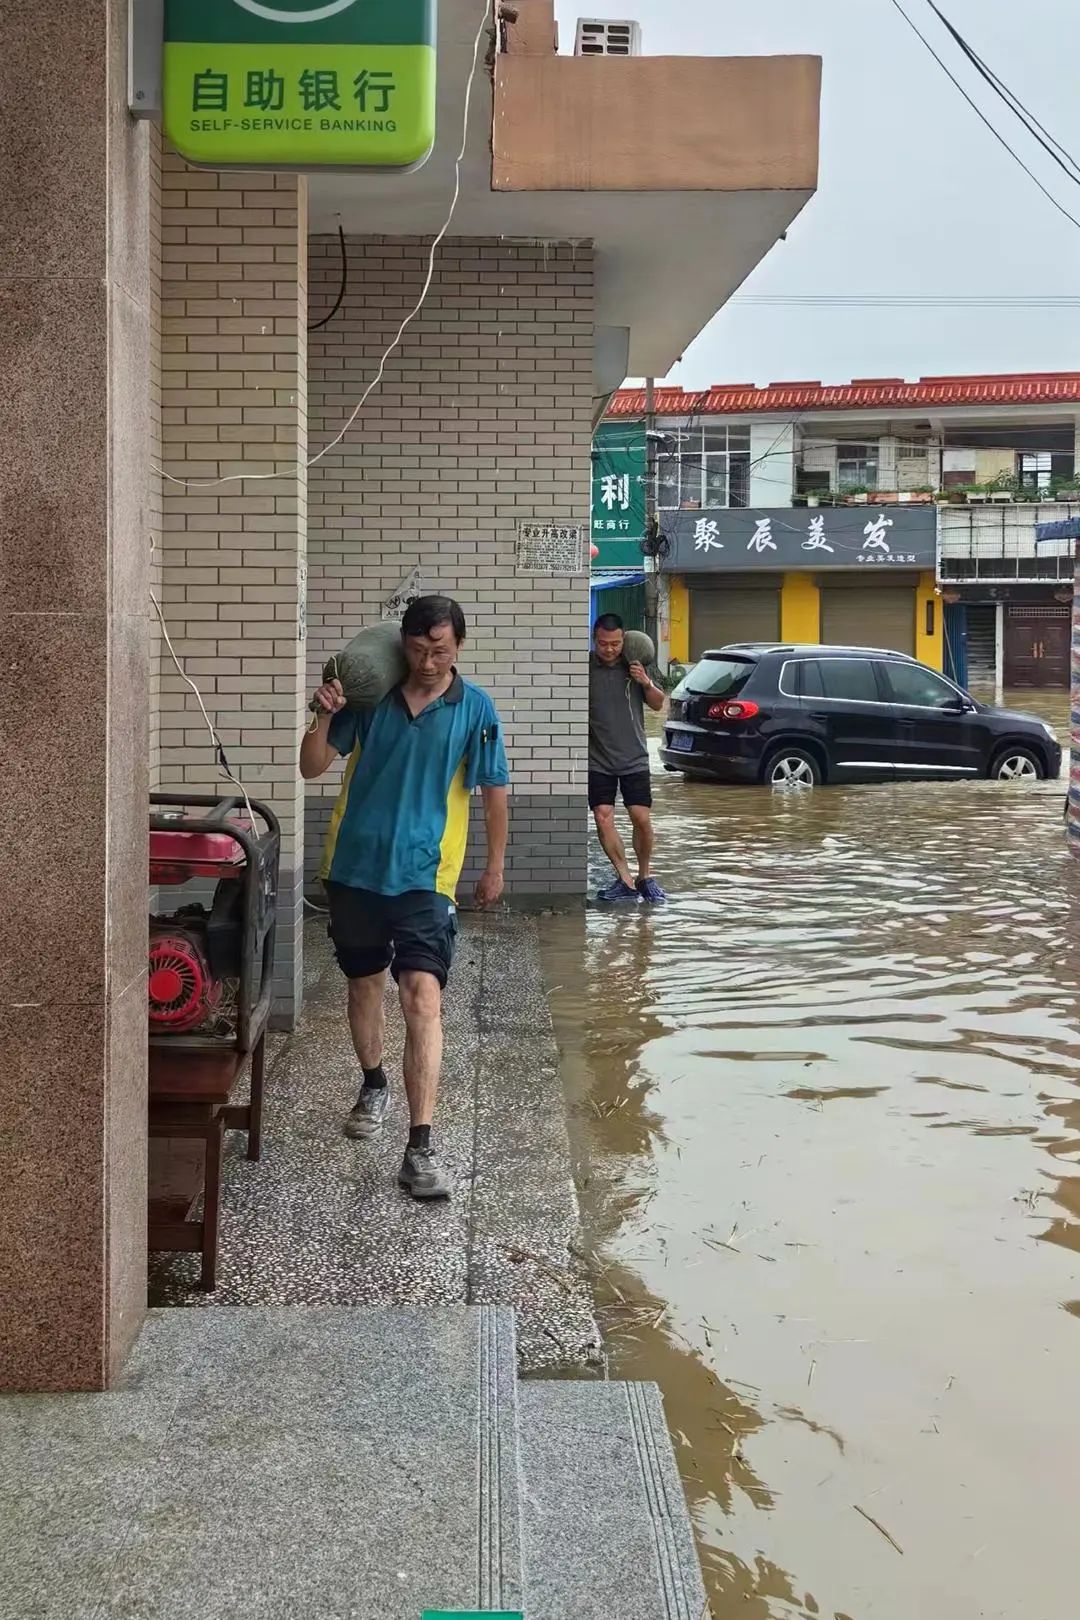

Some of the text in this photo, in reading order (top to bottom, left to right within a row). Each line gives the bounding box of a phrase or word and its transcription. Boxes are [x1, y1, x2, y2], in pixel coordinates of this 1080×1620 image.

[191, 68, 396, 113] 自助银行
[190, 118, 397, 132] SELF-SERVICE BANKING
[600, 473, 630, 511] 利
[693, 513, 893, 553] 聚辰美发
